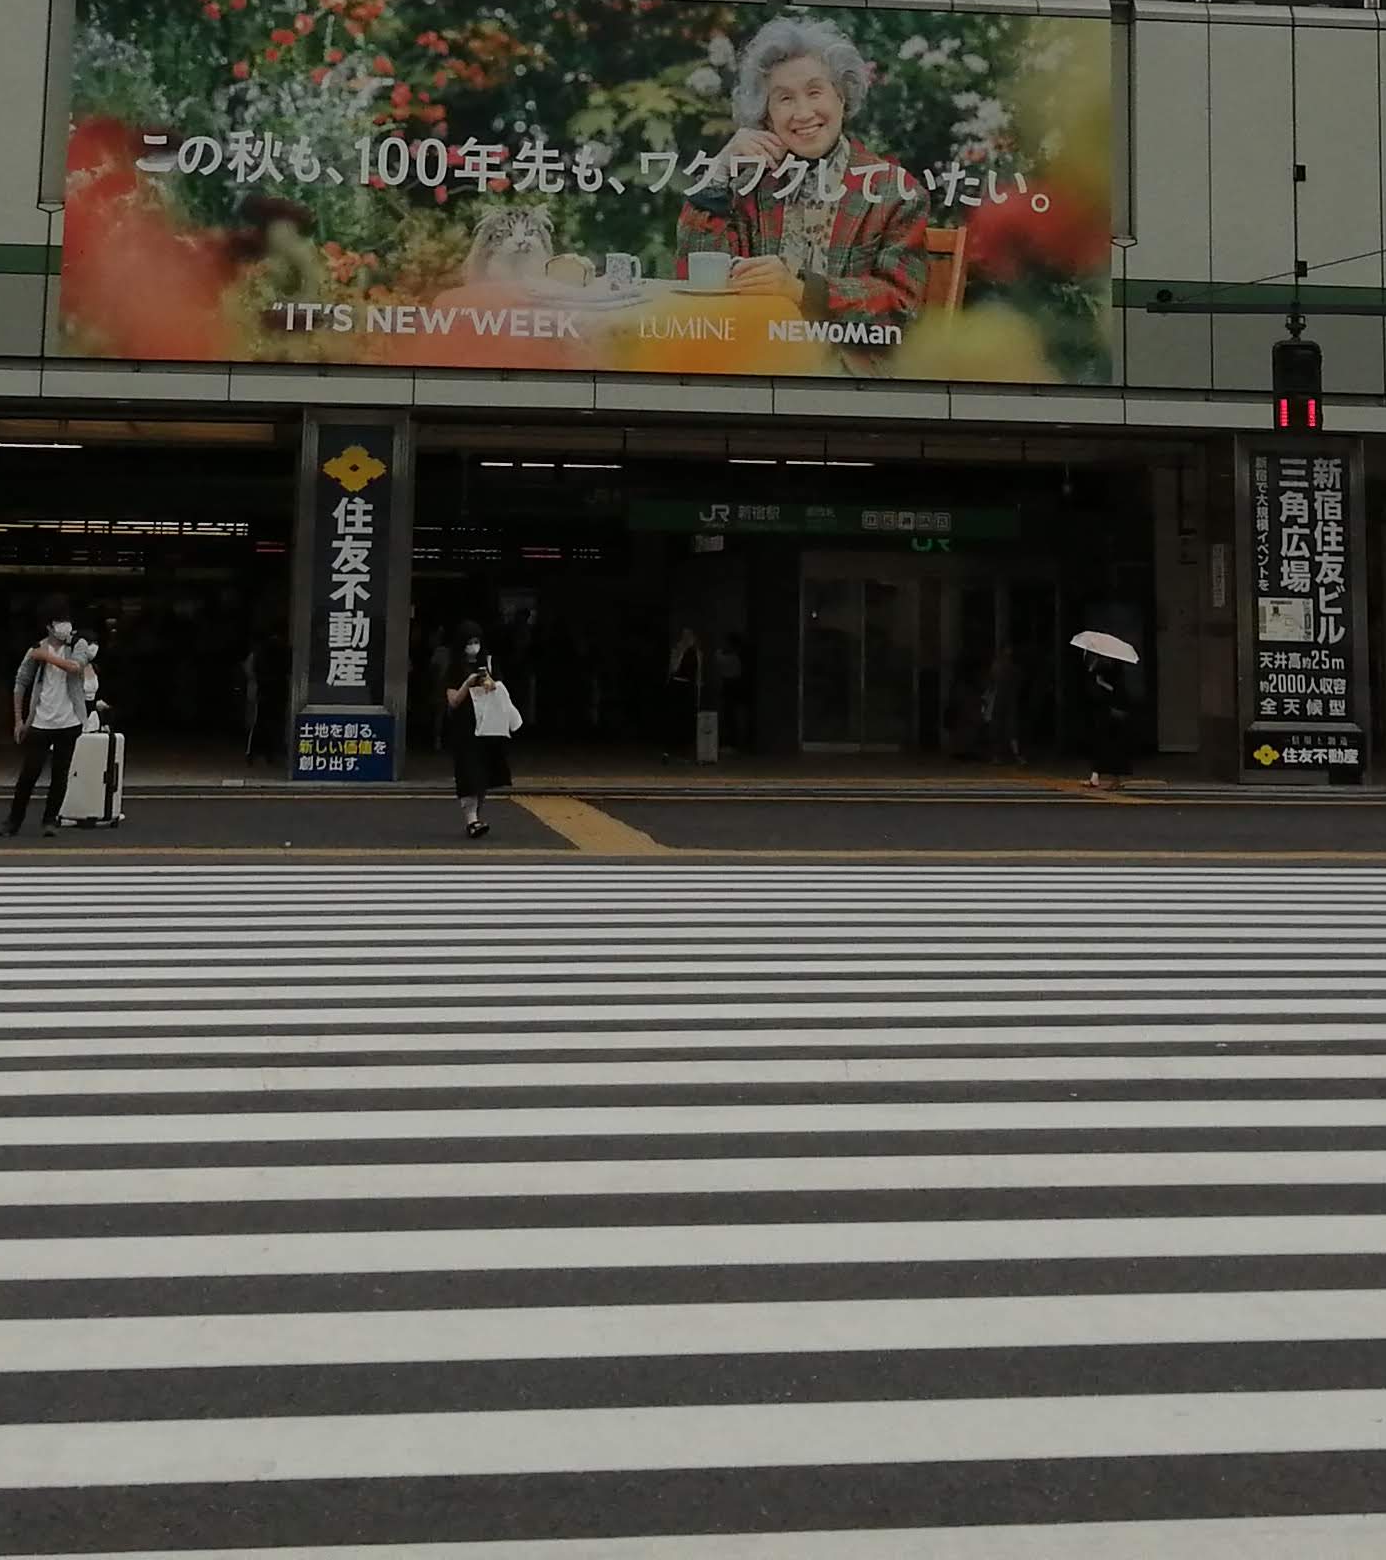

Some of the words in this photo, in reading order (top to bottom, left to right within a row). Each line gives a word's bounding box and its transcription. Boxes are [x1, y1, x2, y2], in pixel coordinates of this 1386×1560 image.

[639, 317, 736, 341] LUMINE
[768, 319, 902, 346] NEWoMan
[1279, 457, 1312, 594] 三角広場
[1312, 457, 1347, 646] 新宿住友ビル
[325, 496, 374, 687] 住友不動産
[1259, 697, 1347, 717] 全天候型
[298, 722, 378, 739] 土地を創る。
[298, 739, 387, 756] 新しい価値を
[1282, 747, 1360, 765] 住友不動産
[298, 755, 361, 772] 創り出す。
